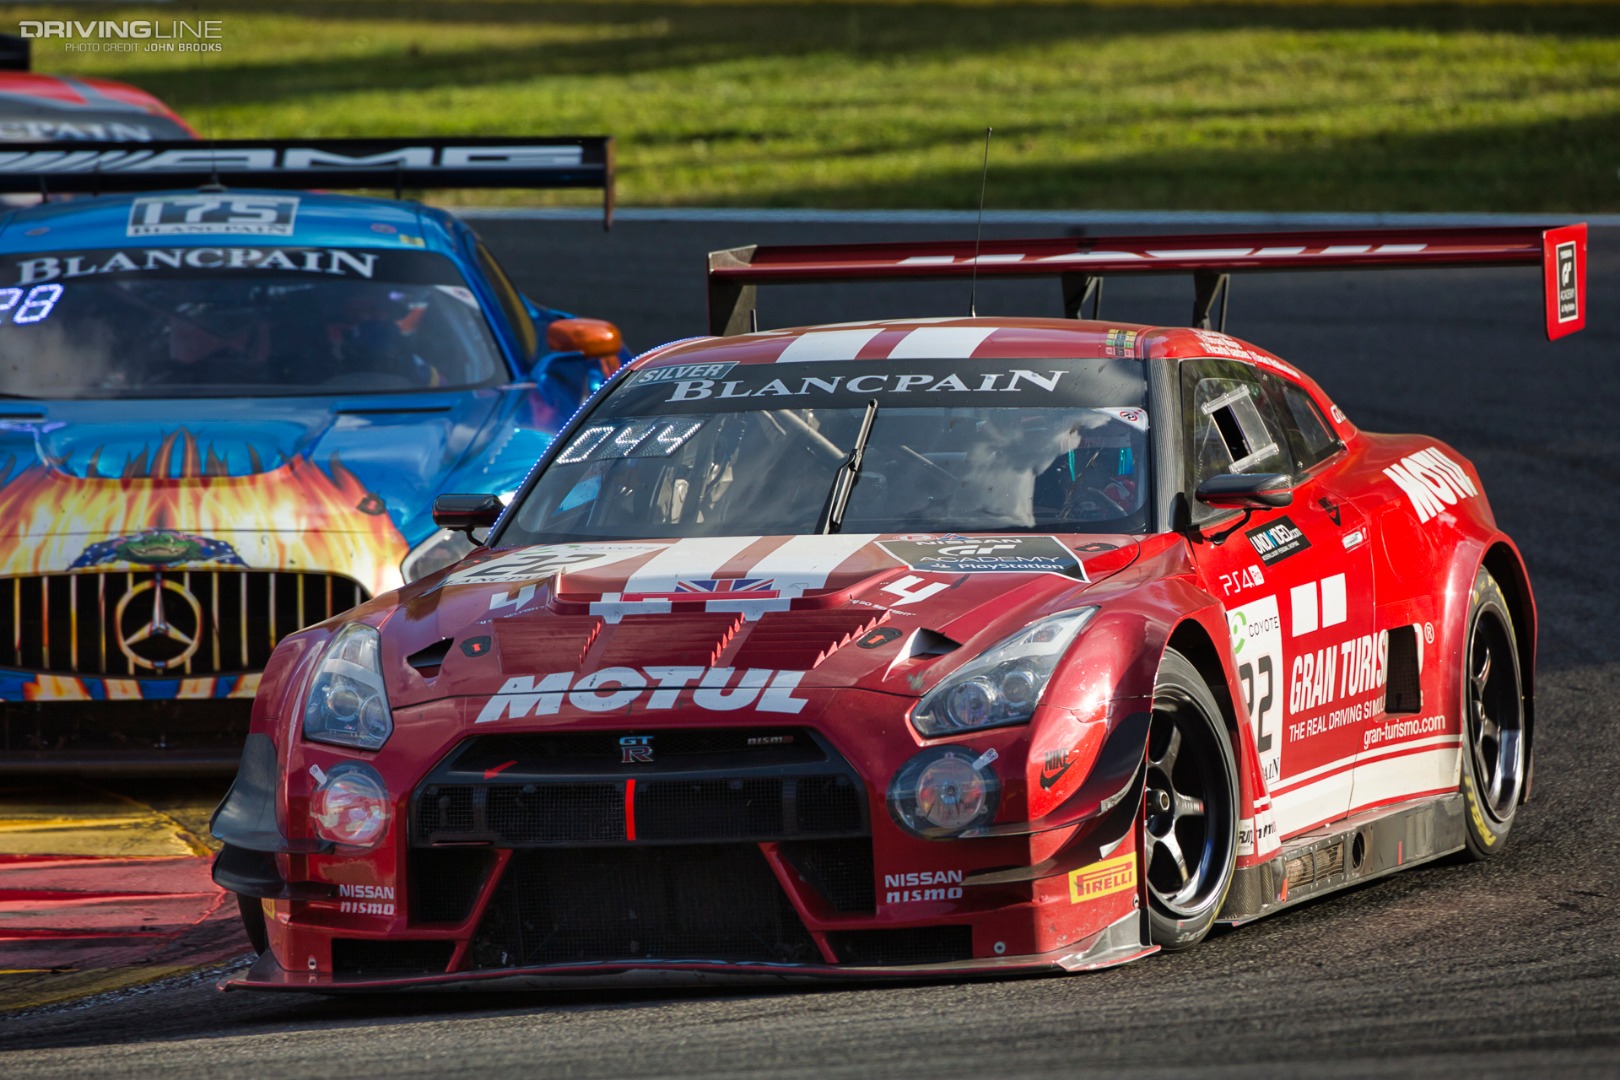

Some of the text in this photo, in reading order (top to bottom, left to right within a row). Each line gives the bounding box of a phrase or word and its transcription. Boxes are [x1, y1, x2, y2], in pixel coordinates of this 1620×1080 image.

[120, 147, 582, 172] AMG
[143, 201, 278, 224] 175
[16, 246, 379, 286] BLANCPAIN
[638, 363, 724, 384] SILVER
[664, 368, 1065, 403] BLANCPAIN
[919, 556, 1060, 564] ACADEMY
[957, 561, 1065, 571] PlayStation
[1219, 569, 1254, 596] PS4
[1248, 615, 1280, 638] COYOTE
[1289, 645, 1338, 715] GRAN
[473, 665, 810, 725] MOTUL
[1288, 721, 1306, 743] THE
[1306, 714, 1327, 738] REAL
[1328, 703, 1363, 733] DRIVING
[1363, 714, 1447, 750] gran-turismo.com
[1045, 749, 1068, 772] NIKE
[885, 869, 962, 888] NISSAN
[1076, 861, 1134, 897] PIRELLI
[339, 884, 395, 900] NISSAN
[886, 887, 963, 904] nismo
[340, 901, 395, 915] nismo
